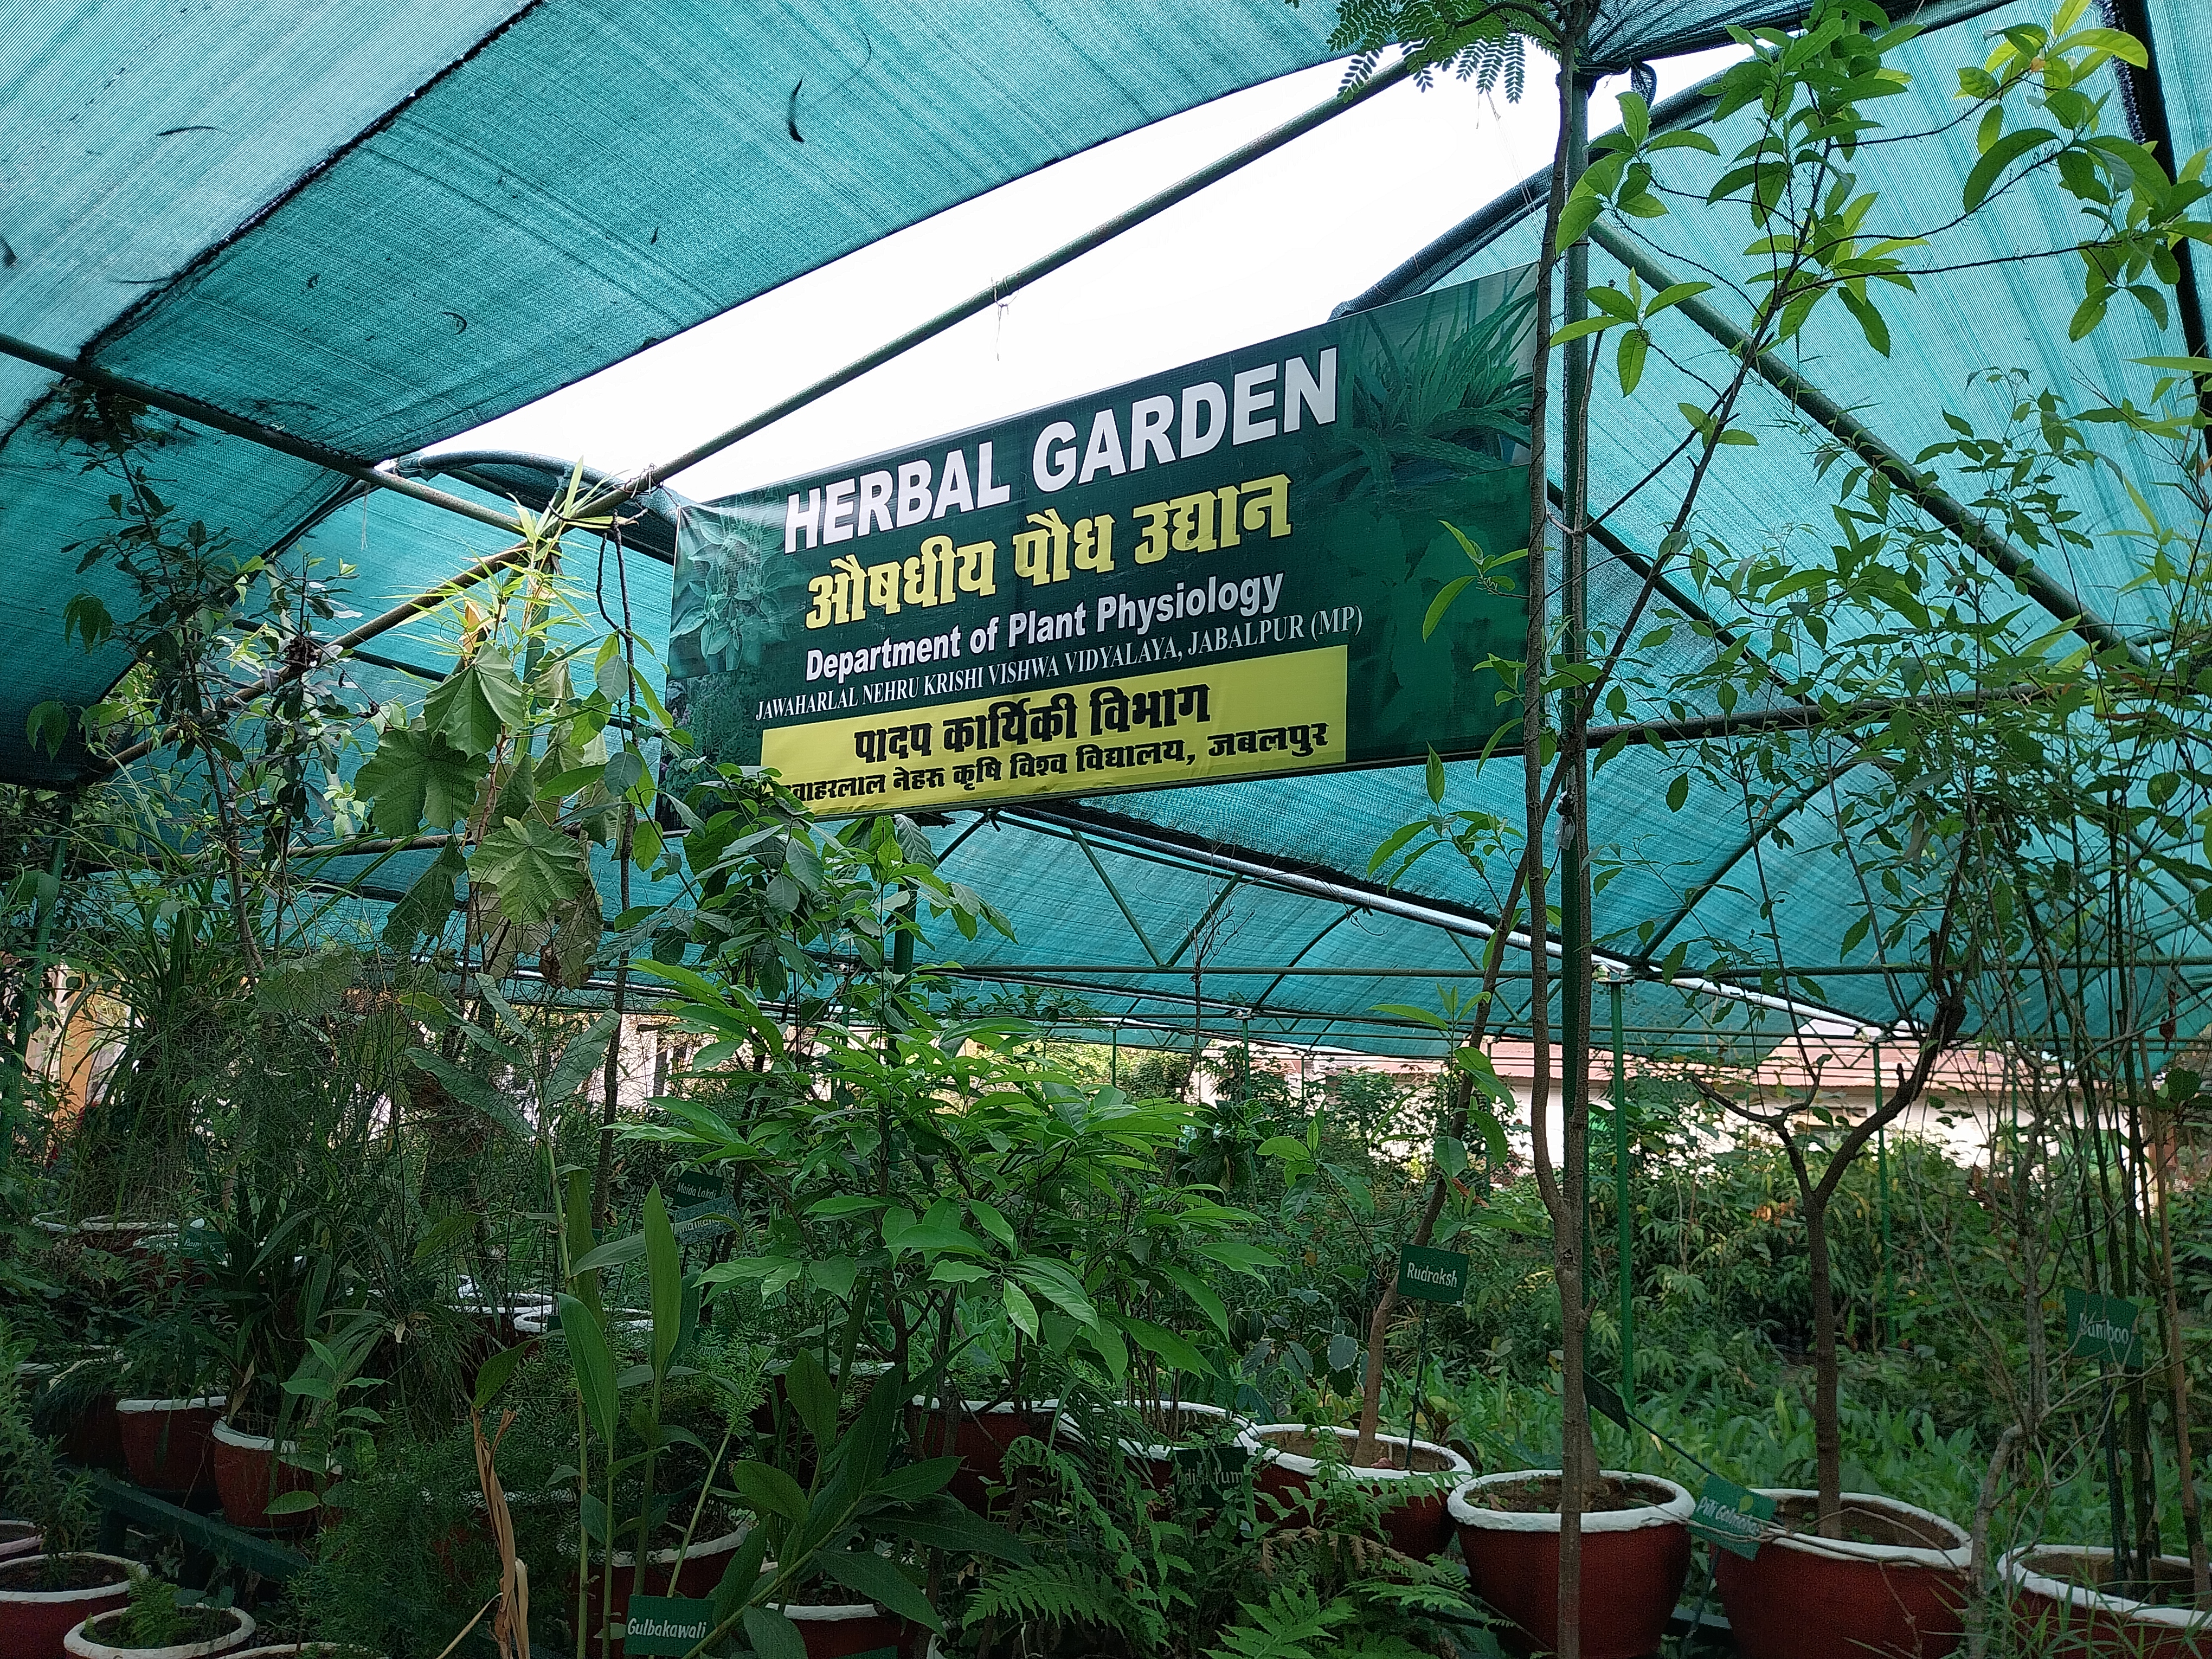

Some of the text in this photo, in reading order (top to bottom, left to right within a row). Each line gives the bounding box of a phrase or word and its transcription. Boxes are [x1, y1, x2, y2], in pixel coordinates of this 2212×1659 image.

[785, 347, 1338, 554] HERBAL GARDEN
[805, 473, 1292, 629] औषधीय पौध उद्यान
[755, 605, 1363, 721] JAWAHARLAL NEHRU KRISHI VISHWA VIDYALAYA, JABALPUR (MP)
[806, 571, 1284, 683] Department of Plant Physiology
[781, 774, 886, 801] वाहरलाल
[952, 756, 1002, 790] कृषि
[1009, 753, 1069, 779] विश्व
[1076, 740, 1196, 772] विद्यालय,
[1207, 723, 1329, 757] जबलपुर
[854, 684, 1211, 764] पादप कार्यिकी विभाग
[1407, 1262, 1458, 1288] Rudraksh
[627, 1617, 707, 1639] Gulbakawali
